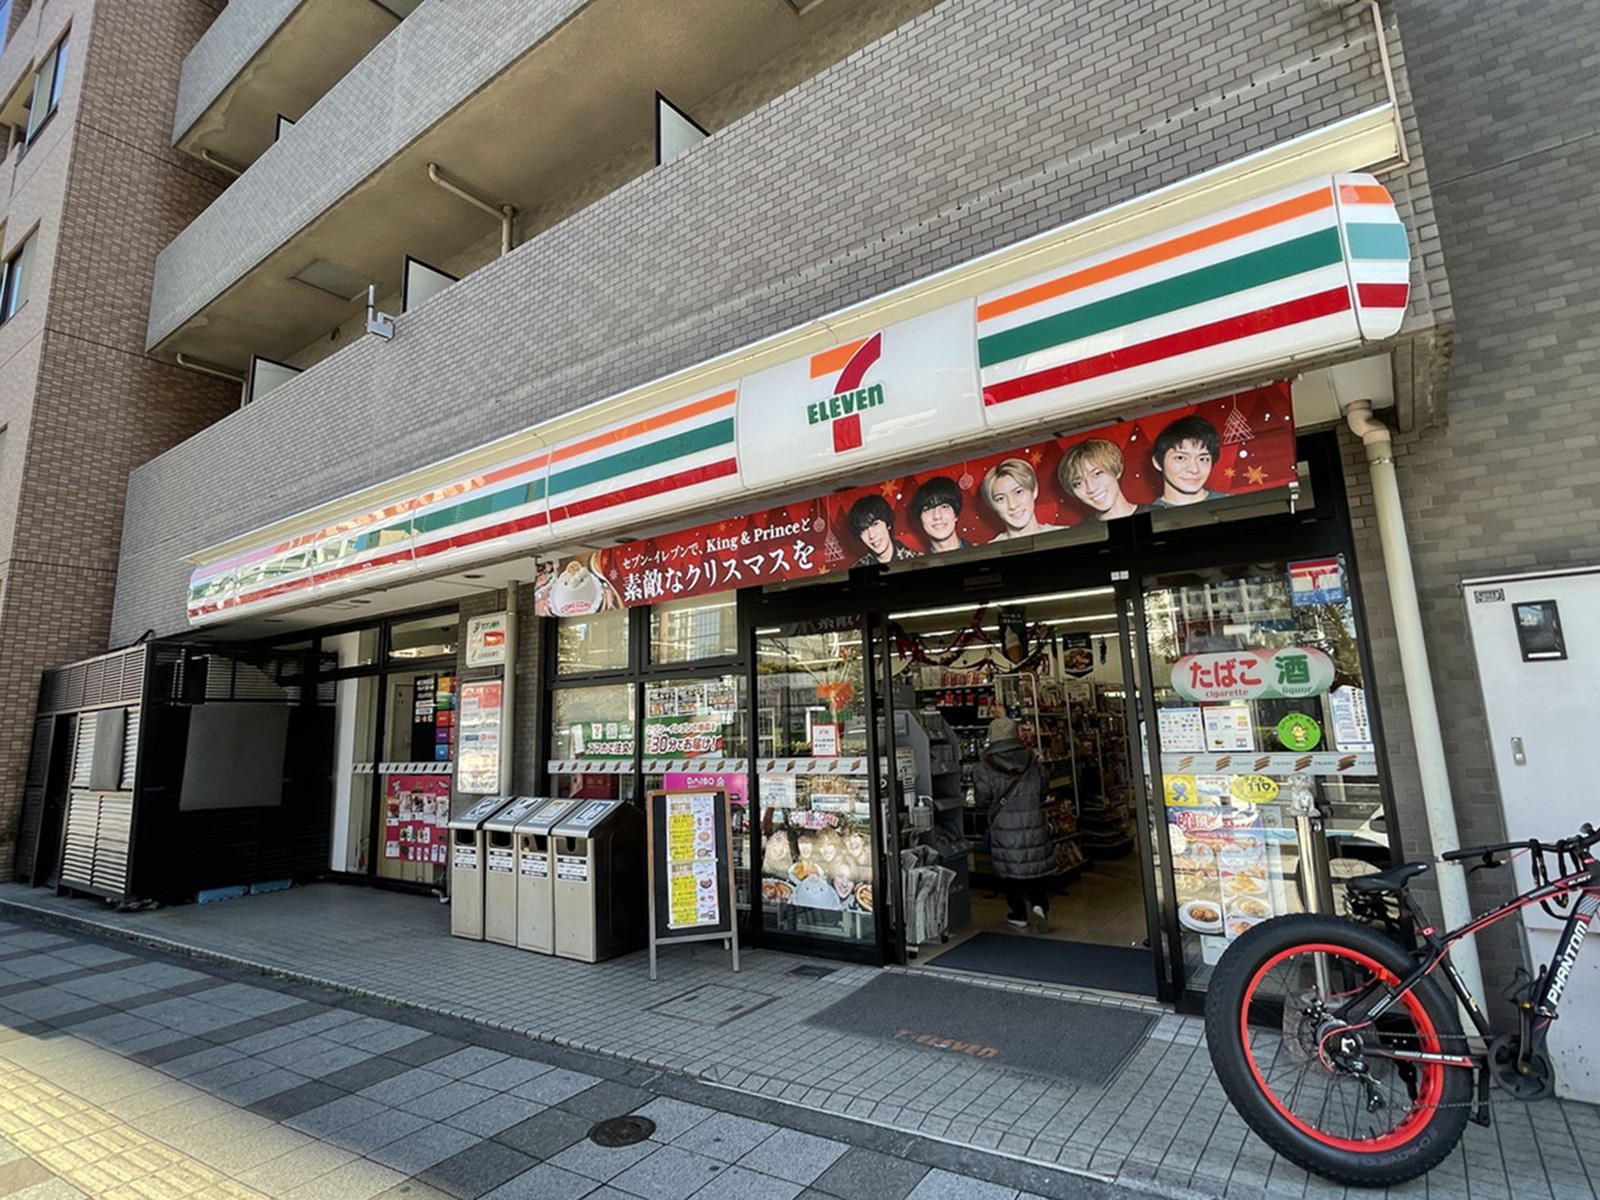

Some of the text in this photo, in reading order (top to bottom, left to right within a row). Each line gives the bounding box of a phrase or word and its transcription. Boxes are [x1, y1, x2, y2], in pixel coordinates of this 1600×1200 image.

[810, 332, 882, 453] 7
[706, 534, 738, 554] King
[740, 531, 751, 546] &
[622, 540, 815, 602] 素敵なクリスマスを
[1189, 654, 1311, 690] たばこ 酒
[1204, 685, 1313, 699] cigarette liquor
[1547, 920, 1588, 1006] PHANTOM
